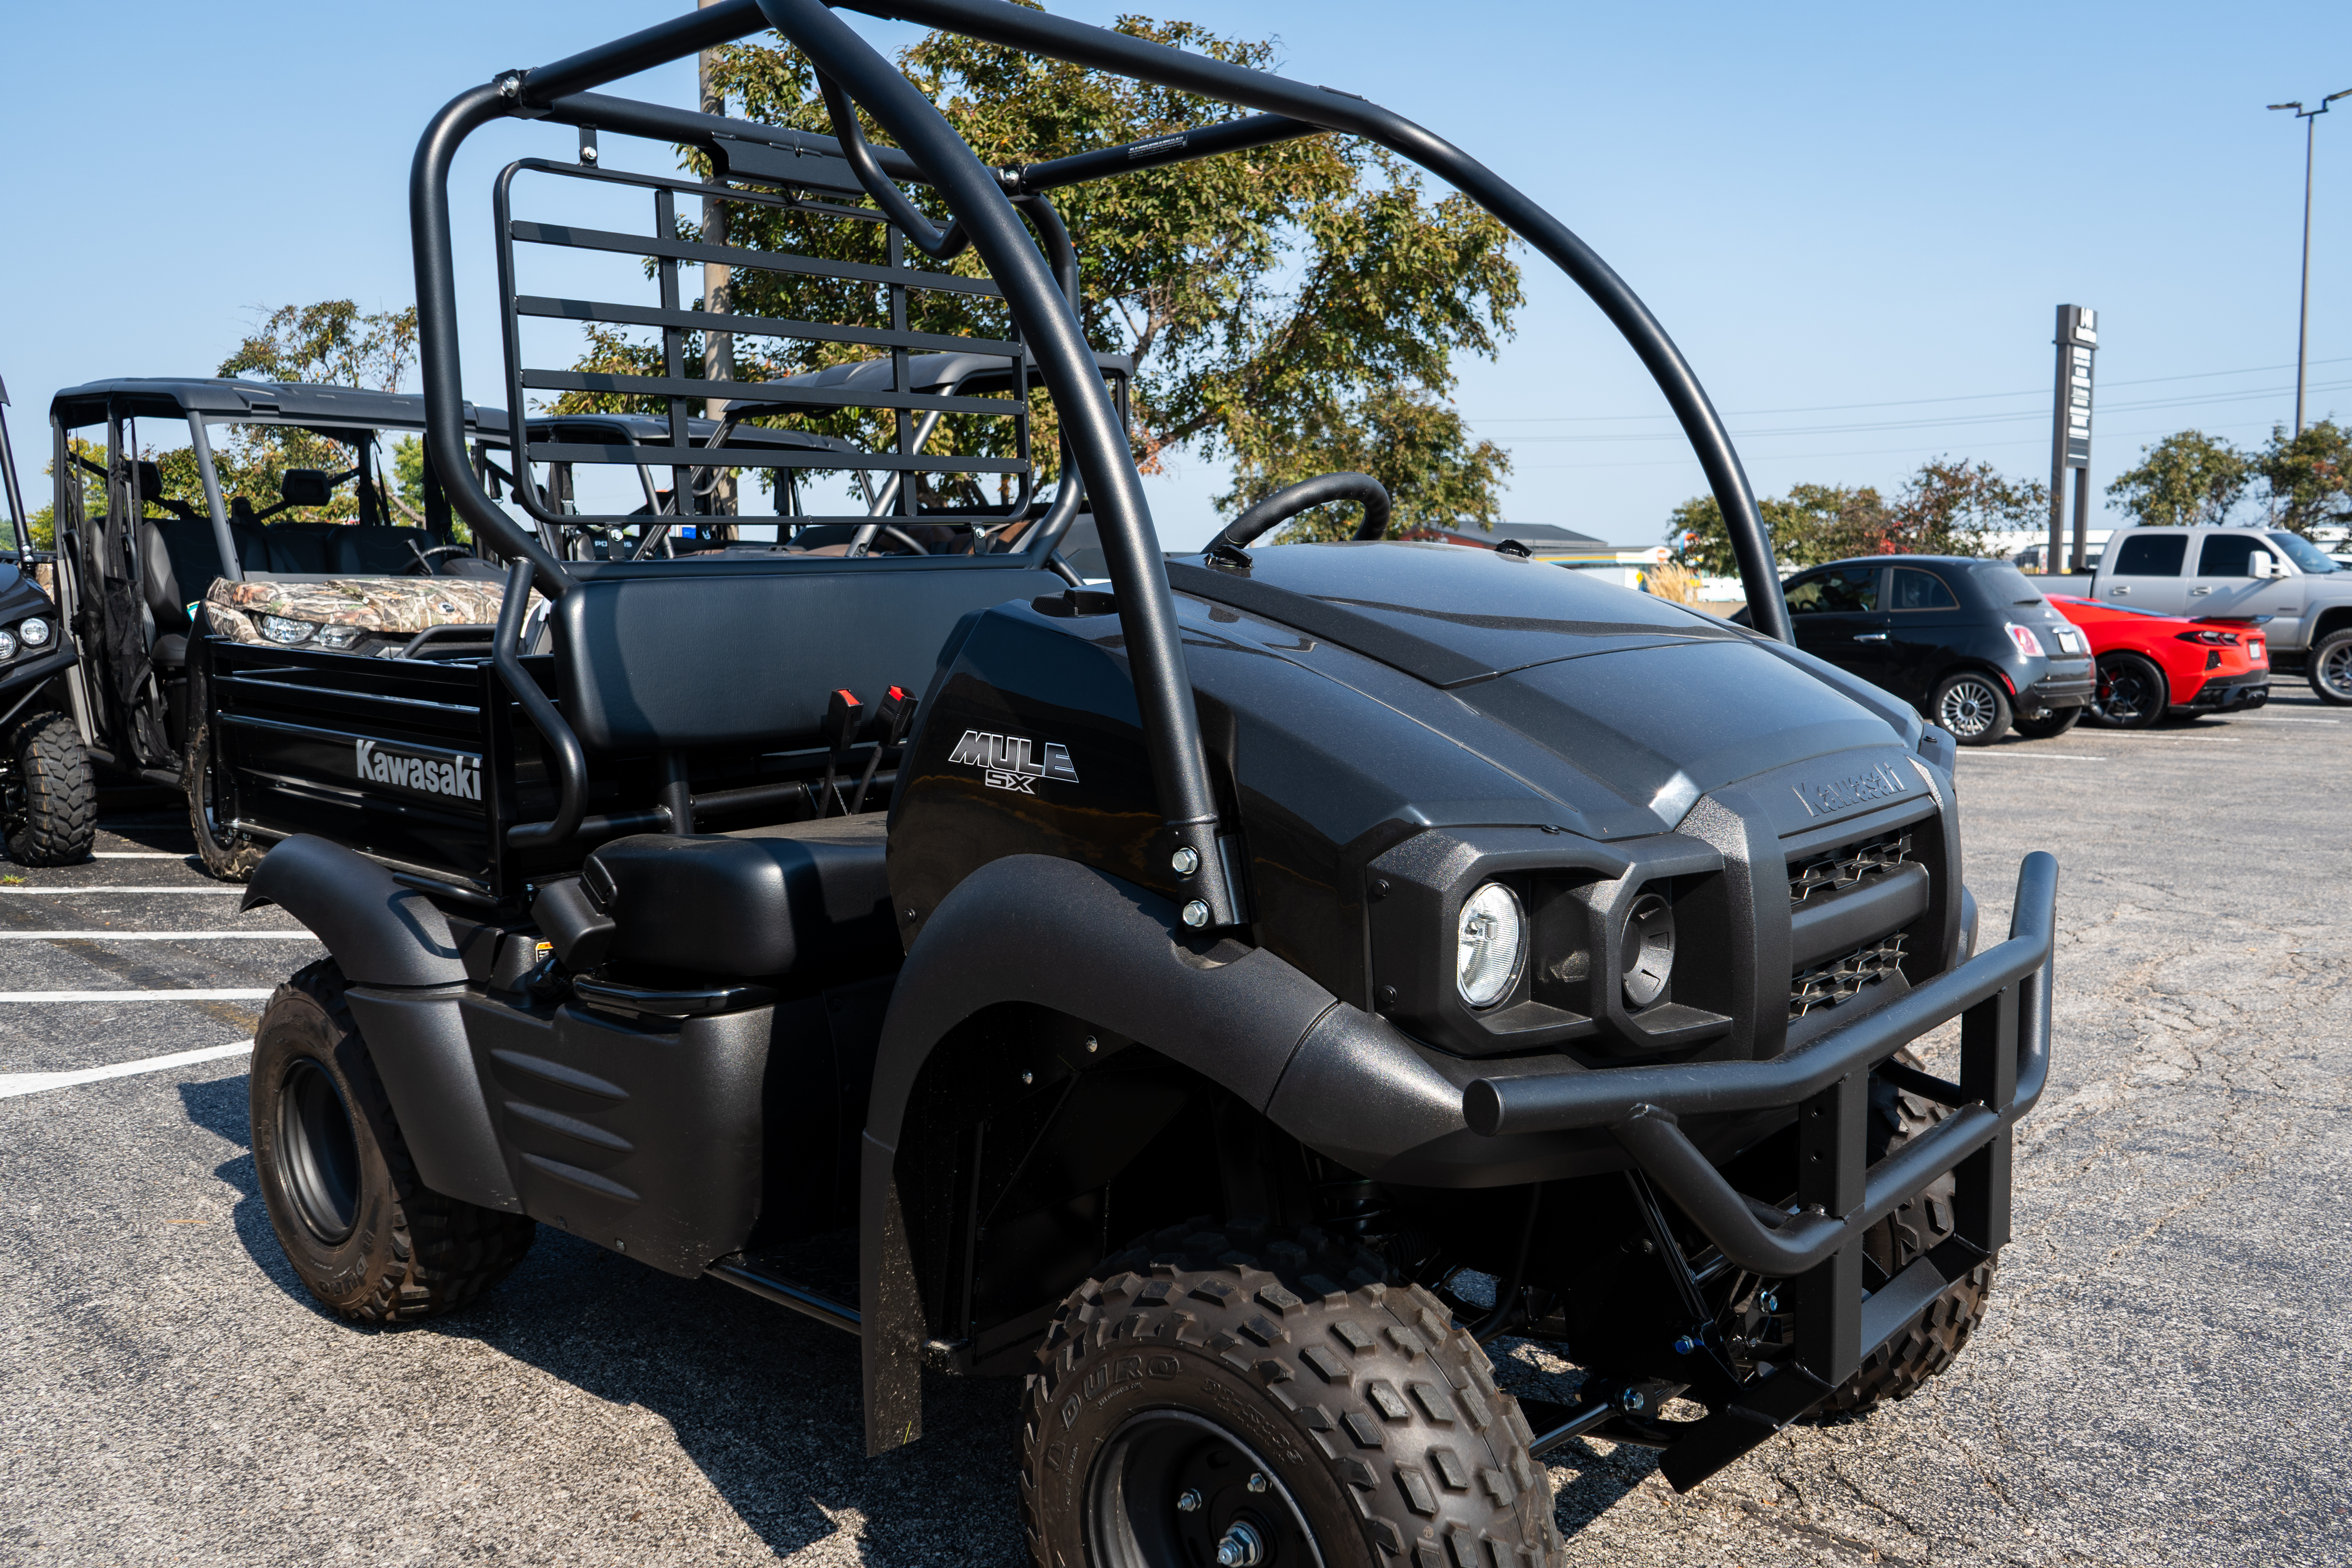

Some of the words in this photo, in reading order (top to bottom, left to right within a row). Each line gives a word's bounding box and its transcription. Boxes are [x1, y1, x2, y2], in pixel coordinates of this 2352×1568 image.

[356, 739, 482, 800] Kawasaki
[948, 730, 1079, 783] MULE
[985, 769, 1037, 795] SX
[1791, 762, 1908, 817] Kawasaki
[1060, 1354, 1179, 1432] DURO
